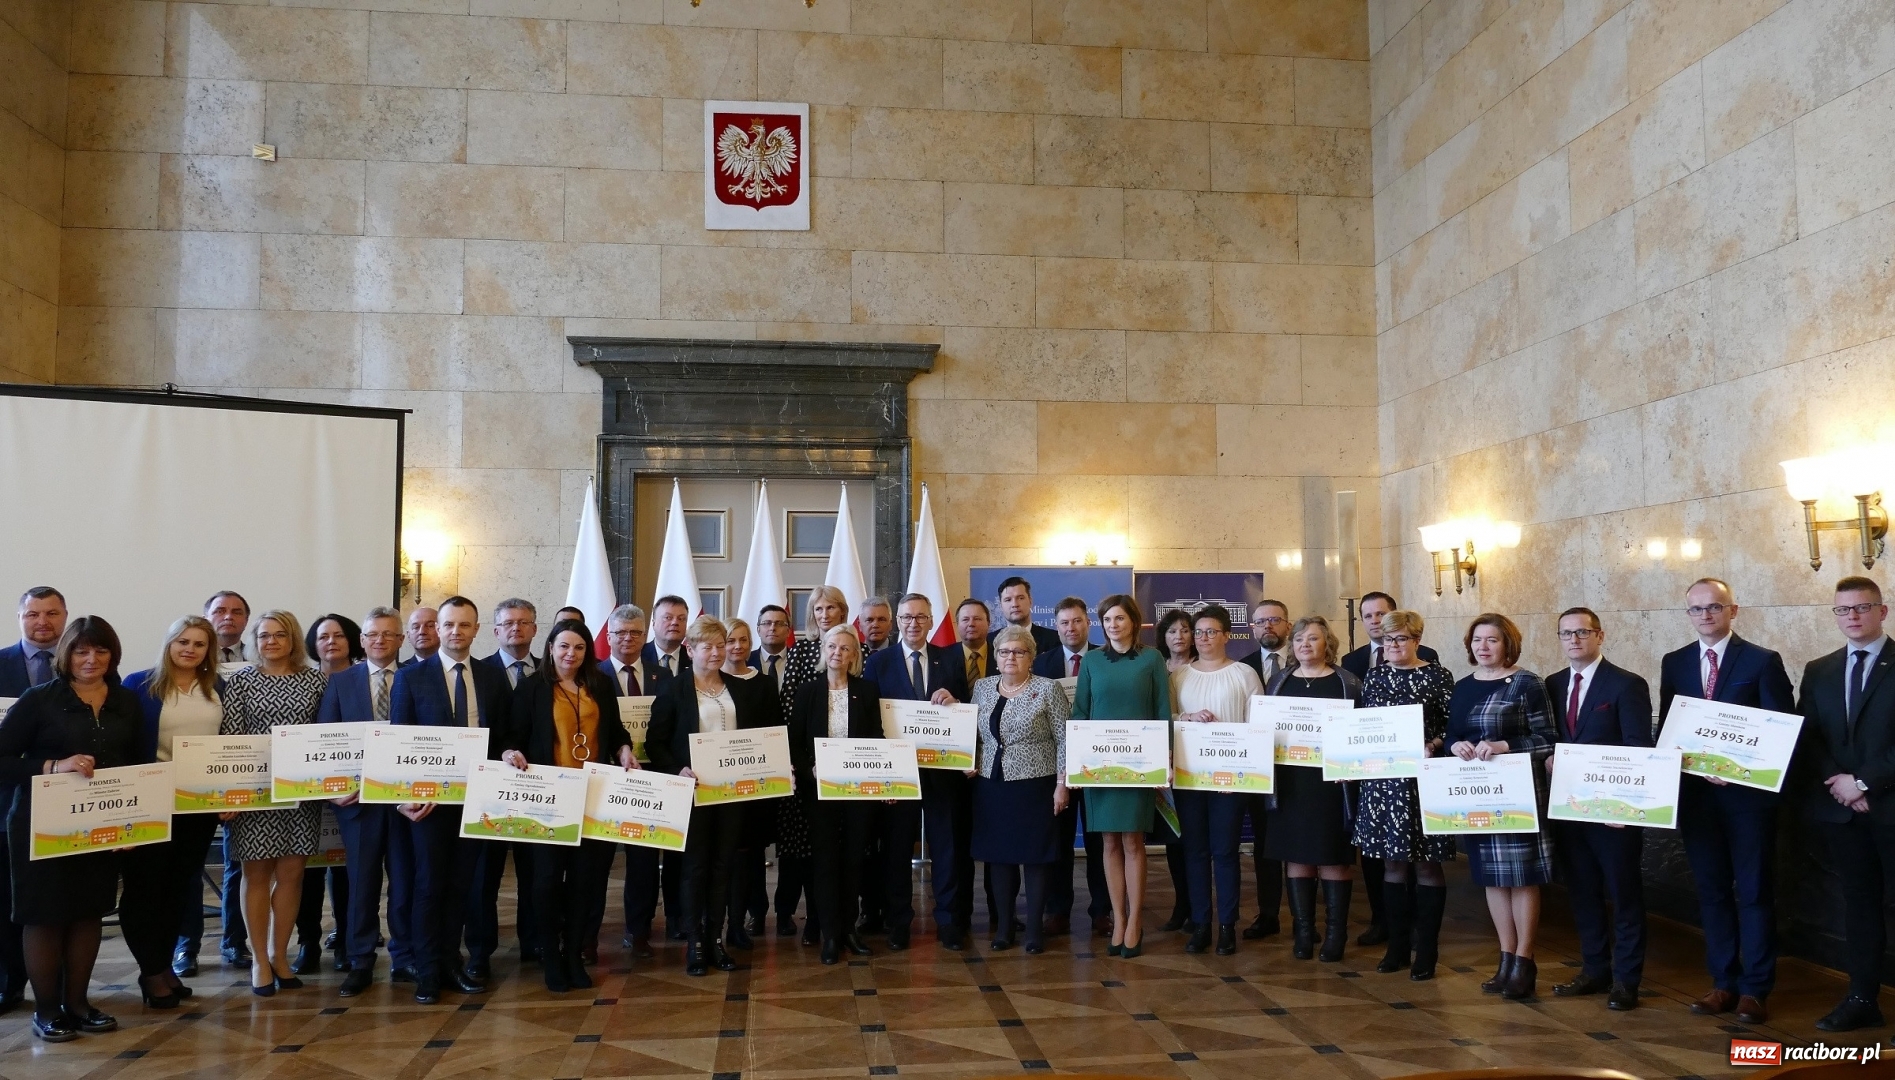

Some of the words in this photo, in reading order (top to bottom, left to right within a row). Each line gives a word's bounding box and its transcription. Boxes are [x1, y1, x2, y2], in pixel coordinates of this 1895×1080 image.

[1030, 604, 1056, 614] Minist
[1228, 632, 1250, 640] ÓDZKI
[1718, 712, 1748, 722] PROMESA
[903, 726, 920, 734] 150
[923, 727, 940, 736] 000
[943, 728, 951, 736] zł
[1275, 722, 1293, 731] 300
[1296, 723, 1314, 732] 000
[1348, 736, 1365, 745] 150
[1367, 734, 1385, 743] 000
[1388, 733, 1397, 742] zł
[1695, 727, 1718, 738] 429
[1720, 731, 1744, 744] 895
[1746, 736, 1759, 747] zł
[1092, 744, 1110, 753] 960
[1113, 745, 1131, 753] 000
[1134, 744, 1142, 753] zł
[1199, 748, 1216, 757] 150
[1219, 749, 1236, 758] 000
[1239, 749, 1248, 758] zł
[304, 753, 326, 763] 142
[329, 750, 351, 761] 400
[354, 750, 364, 760] zł
[396, 755, 417, 765] 146
[421, 756, 442, 765] 920
[445, 756, 456, 765] zł
[718, 758, 736, 767] 150
[738, 756, 755, 765] 000
[758, 754, 766, 763] zł
[206, 765, 228, 774] 300
[232, 764, 254, 774] 000
[257, 762, 268, 773] zł
[88, 778, 121, 787] PROMESA
[626, 778, 652, 786] PROMESA
[1584, 773, 1605, 783] 304
[1609, 774, 1631, 785] 000
[1634, 776, 1645, 786] zł
[1448, 786, 1467, 796] 150
[1470, 785, 1490, 795] 000
[1493, 784, 1503, 794] zł
[498, 790, 519, 801] 713
[522, 792, 543, 803] 940
[545, 795, 556, 804] zł
[608, 794, 628, 805] 300
[631, 797, 651, 808] 000
[653, 801, 663, 811] zł
[70, 802, 95, 814] 117
[98, 798, 123, 811] 000
[126, 796, 139, 807] zł
